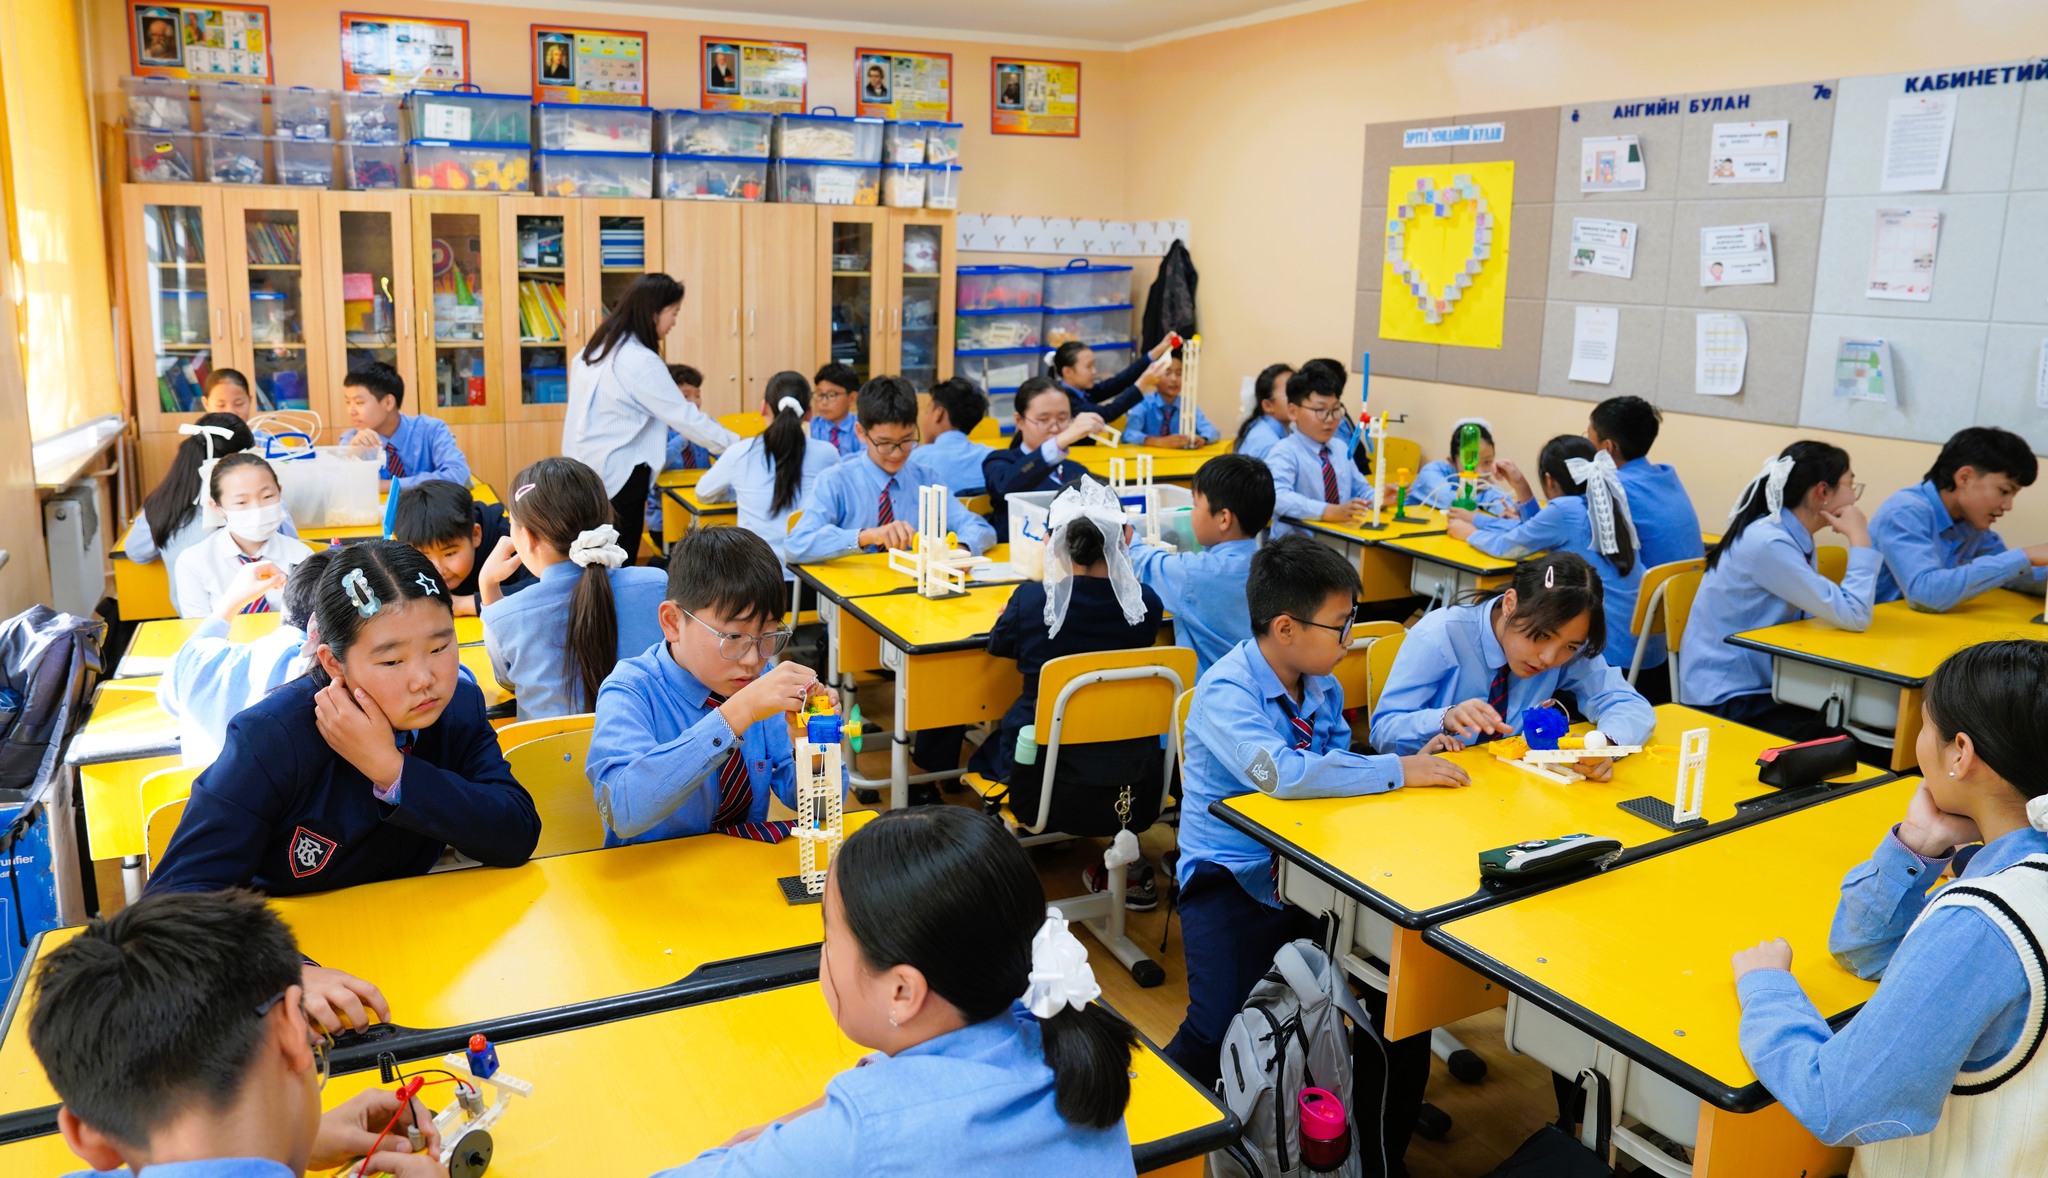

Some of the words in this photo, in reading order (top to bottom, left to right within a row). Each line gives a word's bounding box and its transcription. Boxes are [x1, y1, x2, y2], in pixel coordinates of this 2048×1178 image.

[1613, 99, 1680, 119] АНГИЙН
[1689, 94, 1751, 114] БУЛАН
[0, 855, 35, 867] urifier
